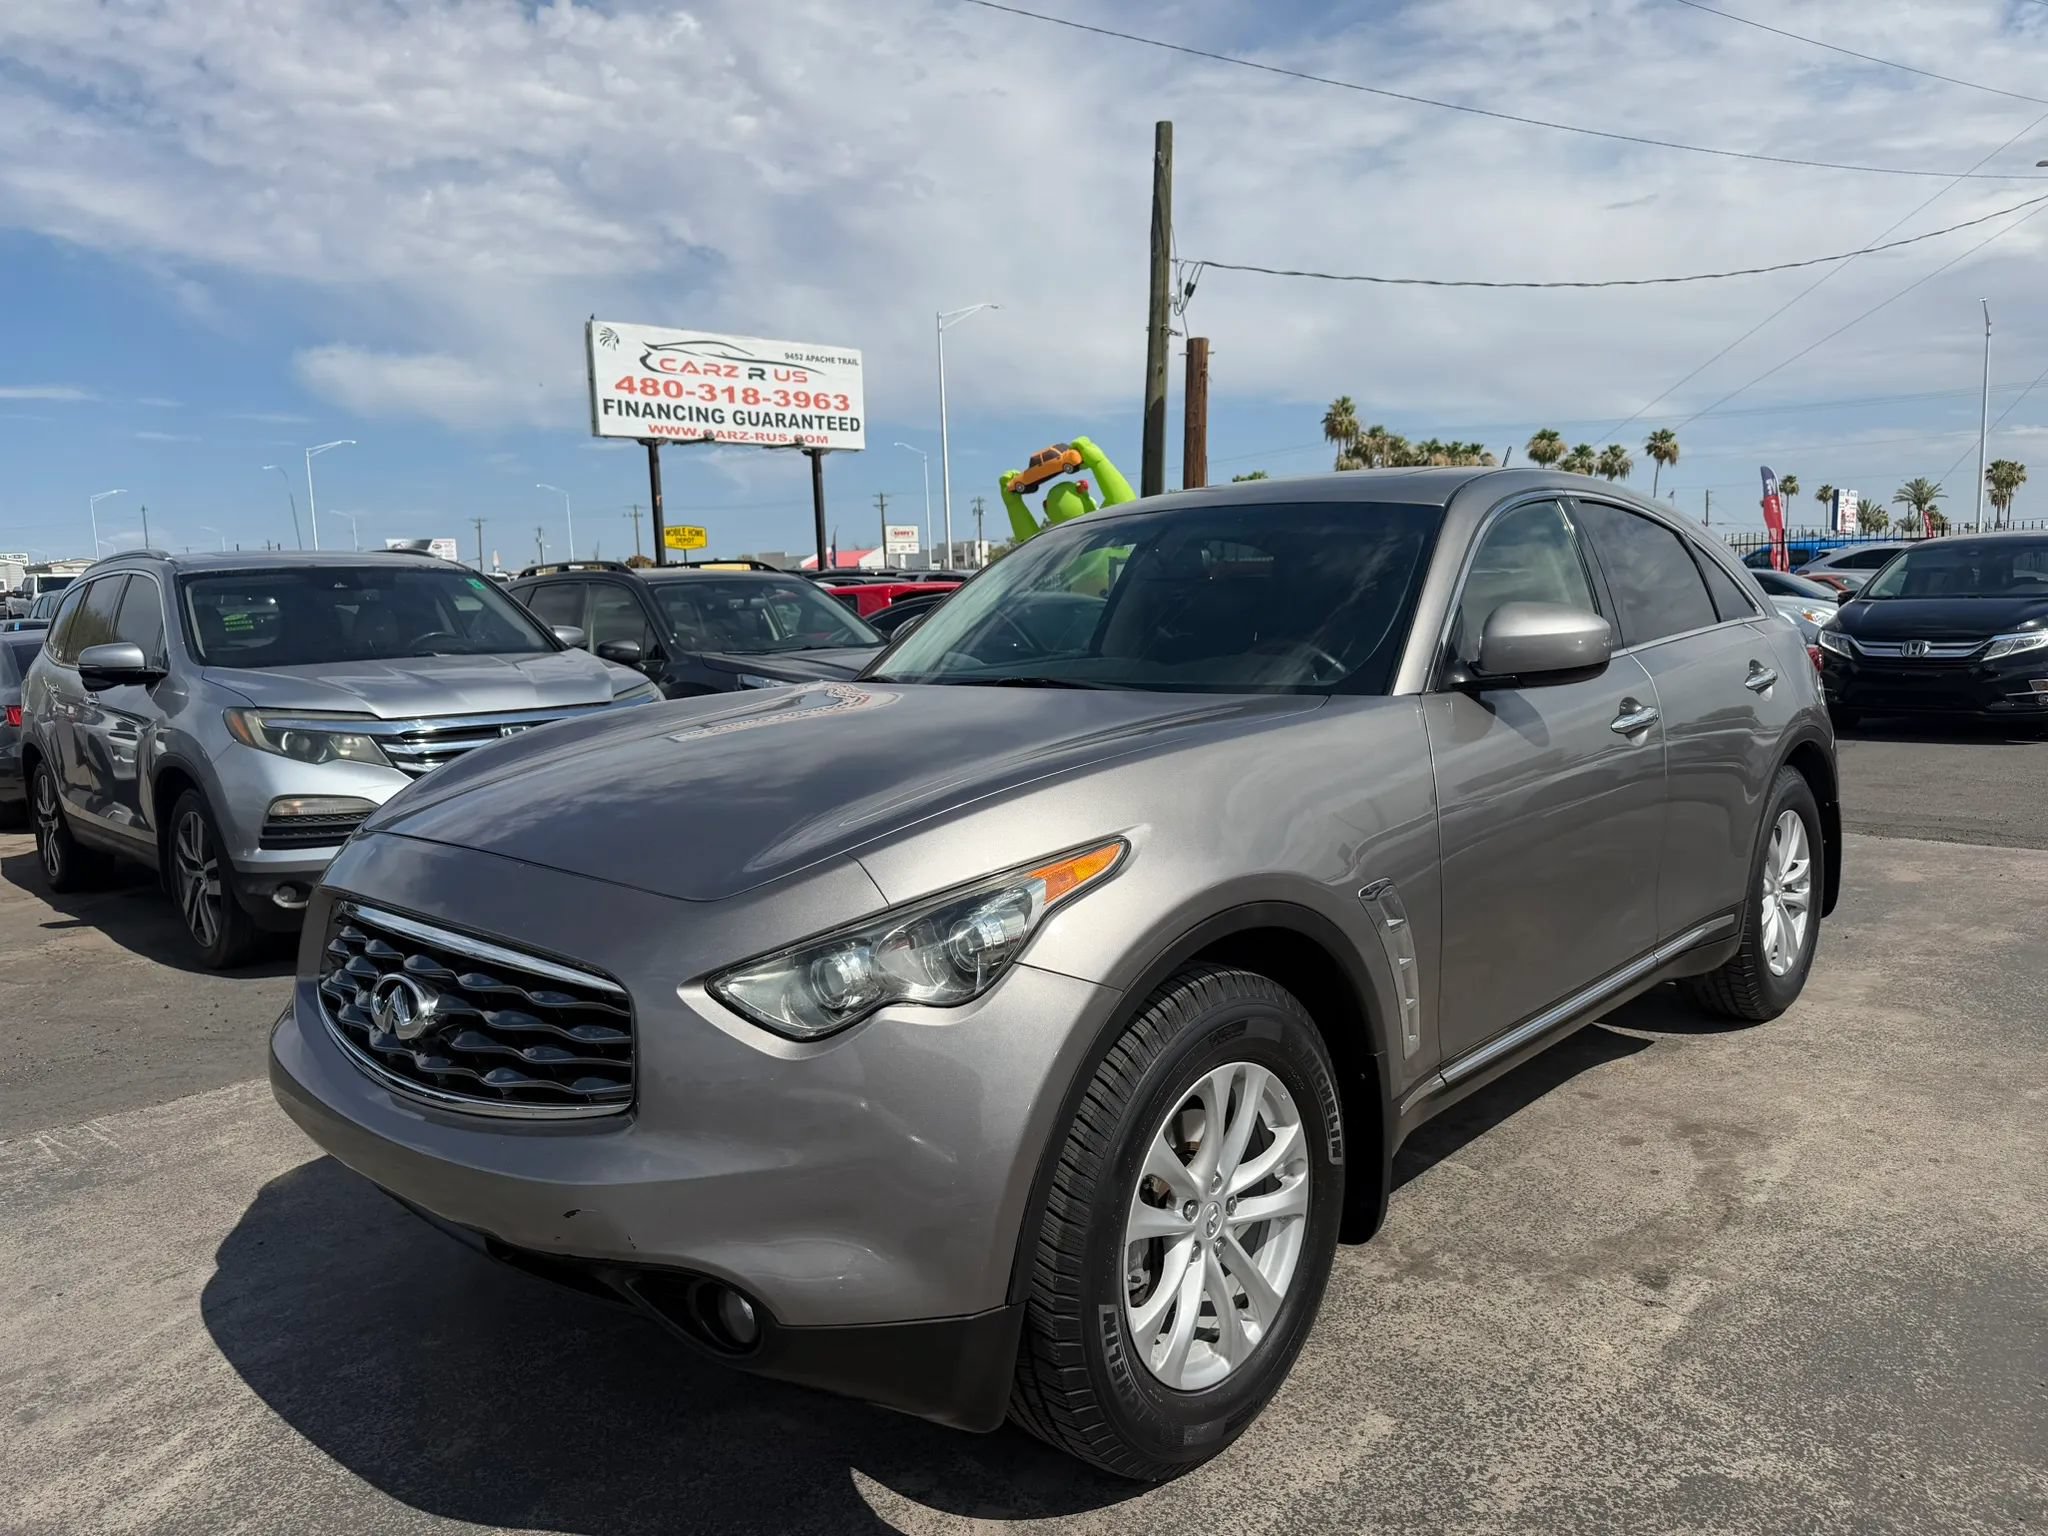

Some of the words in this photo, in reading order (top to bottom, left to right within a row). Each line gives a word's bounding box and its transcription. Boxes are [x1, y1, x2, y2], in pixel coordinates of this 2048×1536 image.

[659, 358, 739, 378] CARZ
[748, 367, 766, 380] R
[774, 368, 808, 383] US
[805, 354, 835, 364] APACHE
[837, 357, 859, 366] TRAIL
[615, 375, 850, 411] 480-318-3963
[603, 398, 725, 424] FINANCING
[732, 410, 860, 432] GUARANTEED
